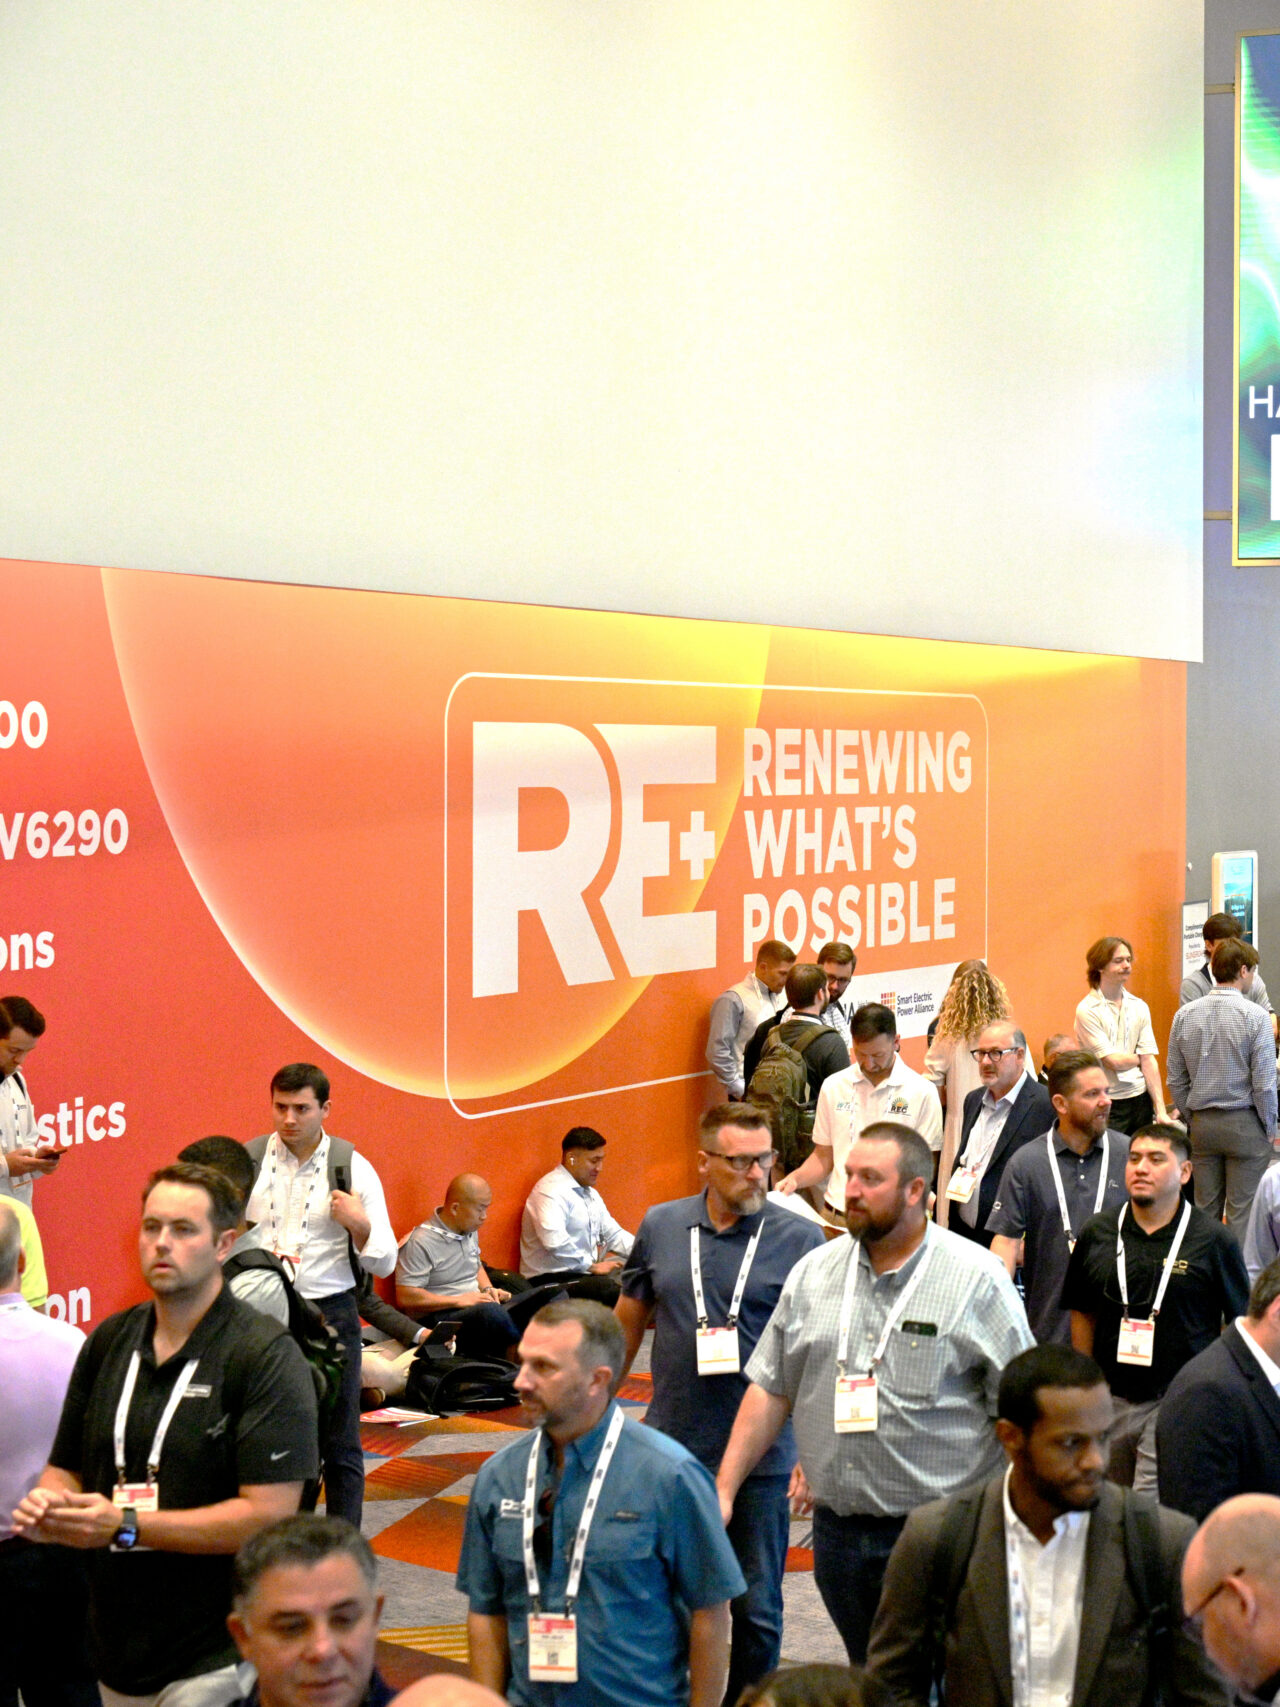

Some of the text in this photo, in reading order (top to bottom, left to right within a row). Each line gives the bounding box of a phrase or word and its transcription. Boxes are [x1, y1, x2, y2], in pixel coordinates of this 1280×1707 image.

[744, 727, 972, 796] RENEWING
[0, 808, 129, 860] V6290
[744, 804, 917, 878] WHAT'S
[744, 877, 956, 963] POSSIBLE
[897, 991, 933, 1005] Smart Electric
[897, 1002, 935, 1017] Power Alliance
[36, 1096, 127, 1149] stics
[891, 1105, 908, 1114] REC
